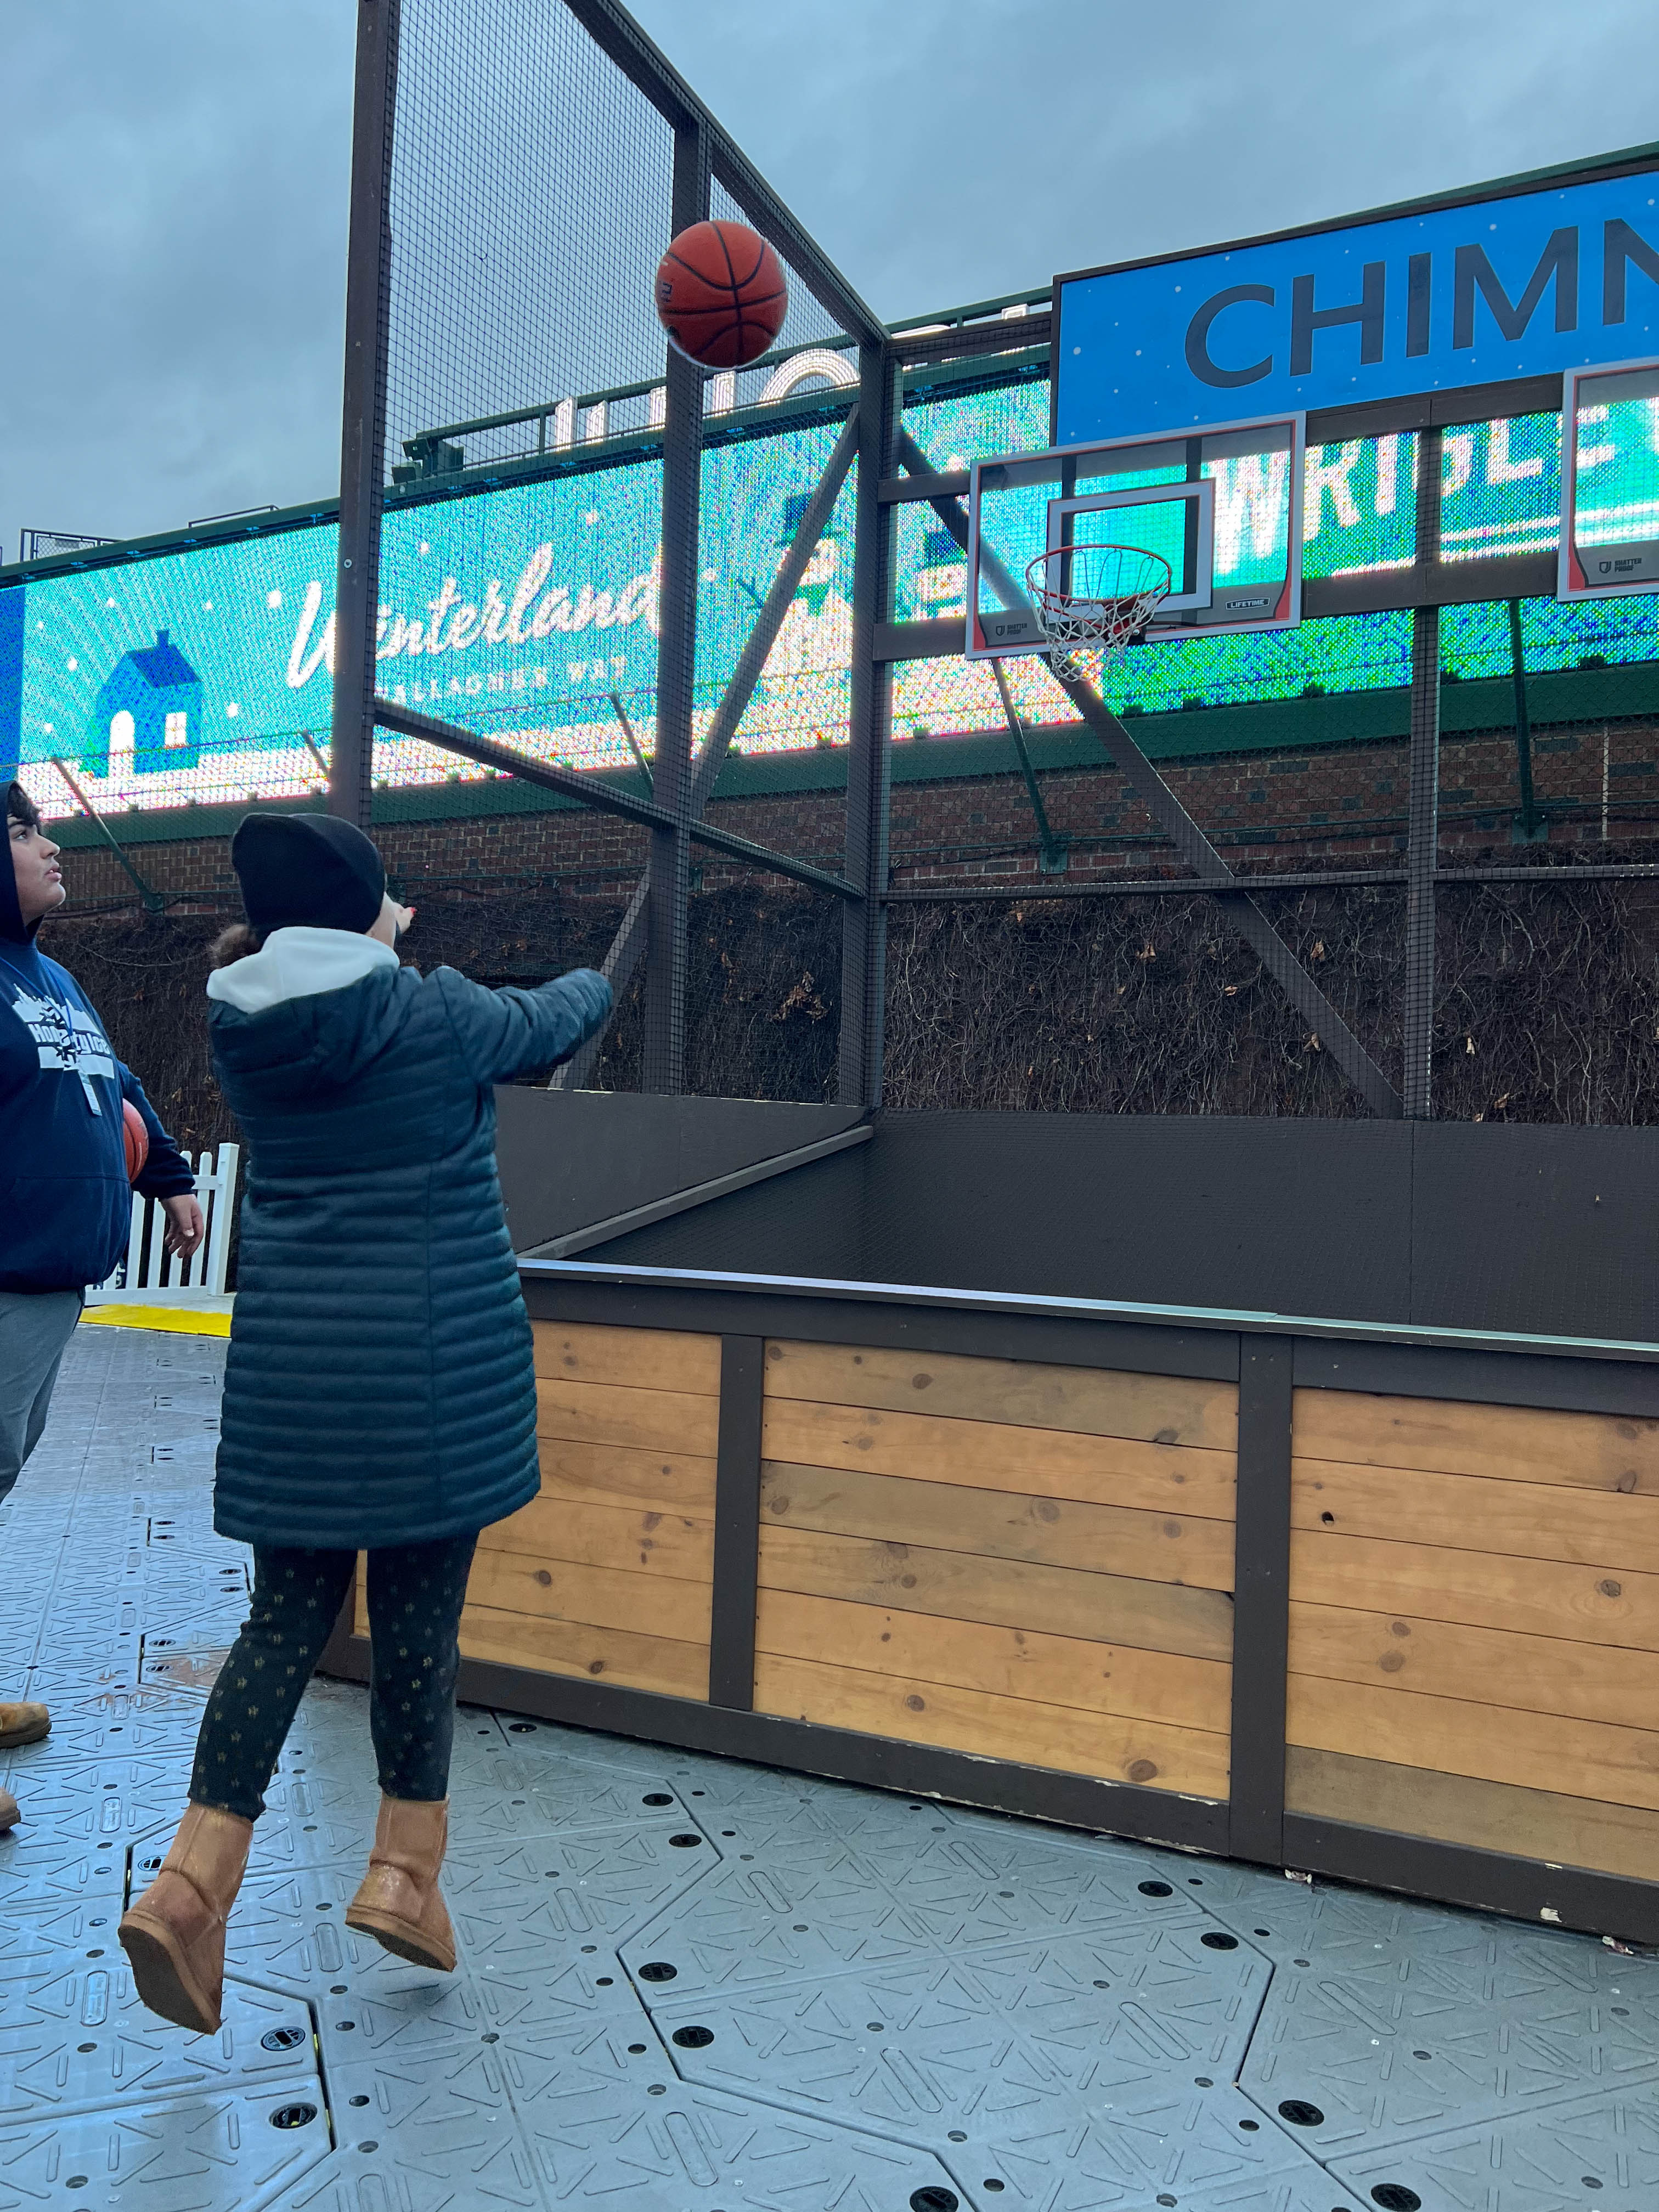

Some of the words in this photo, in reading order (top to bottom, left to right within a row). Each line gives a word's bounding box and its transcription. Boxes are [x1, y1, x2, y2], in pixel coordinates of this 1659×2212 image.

[1615, 558, 1642, 566] SHATTER
[1231, 600, 1264, 608] LIFETIME
[567, 656, 628, 682] WAY
